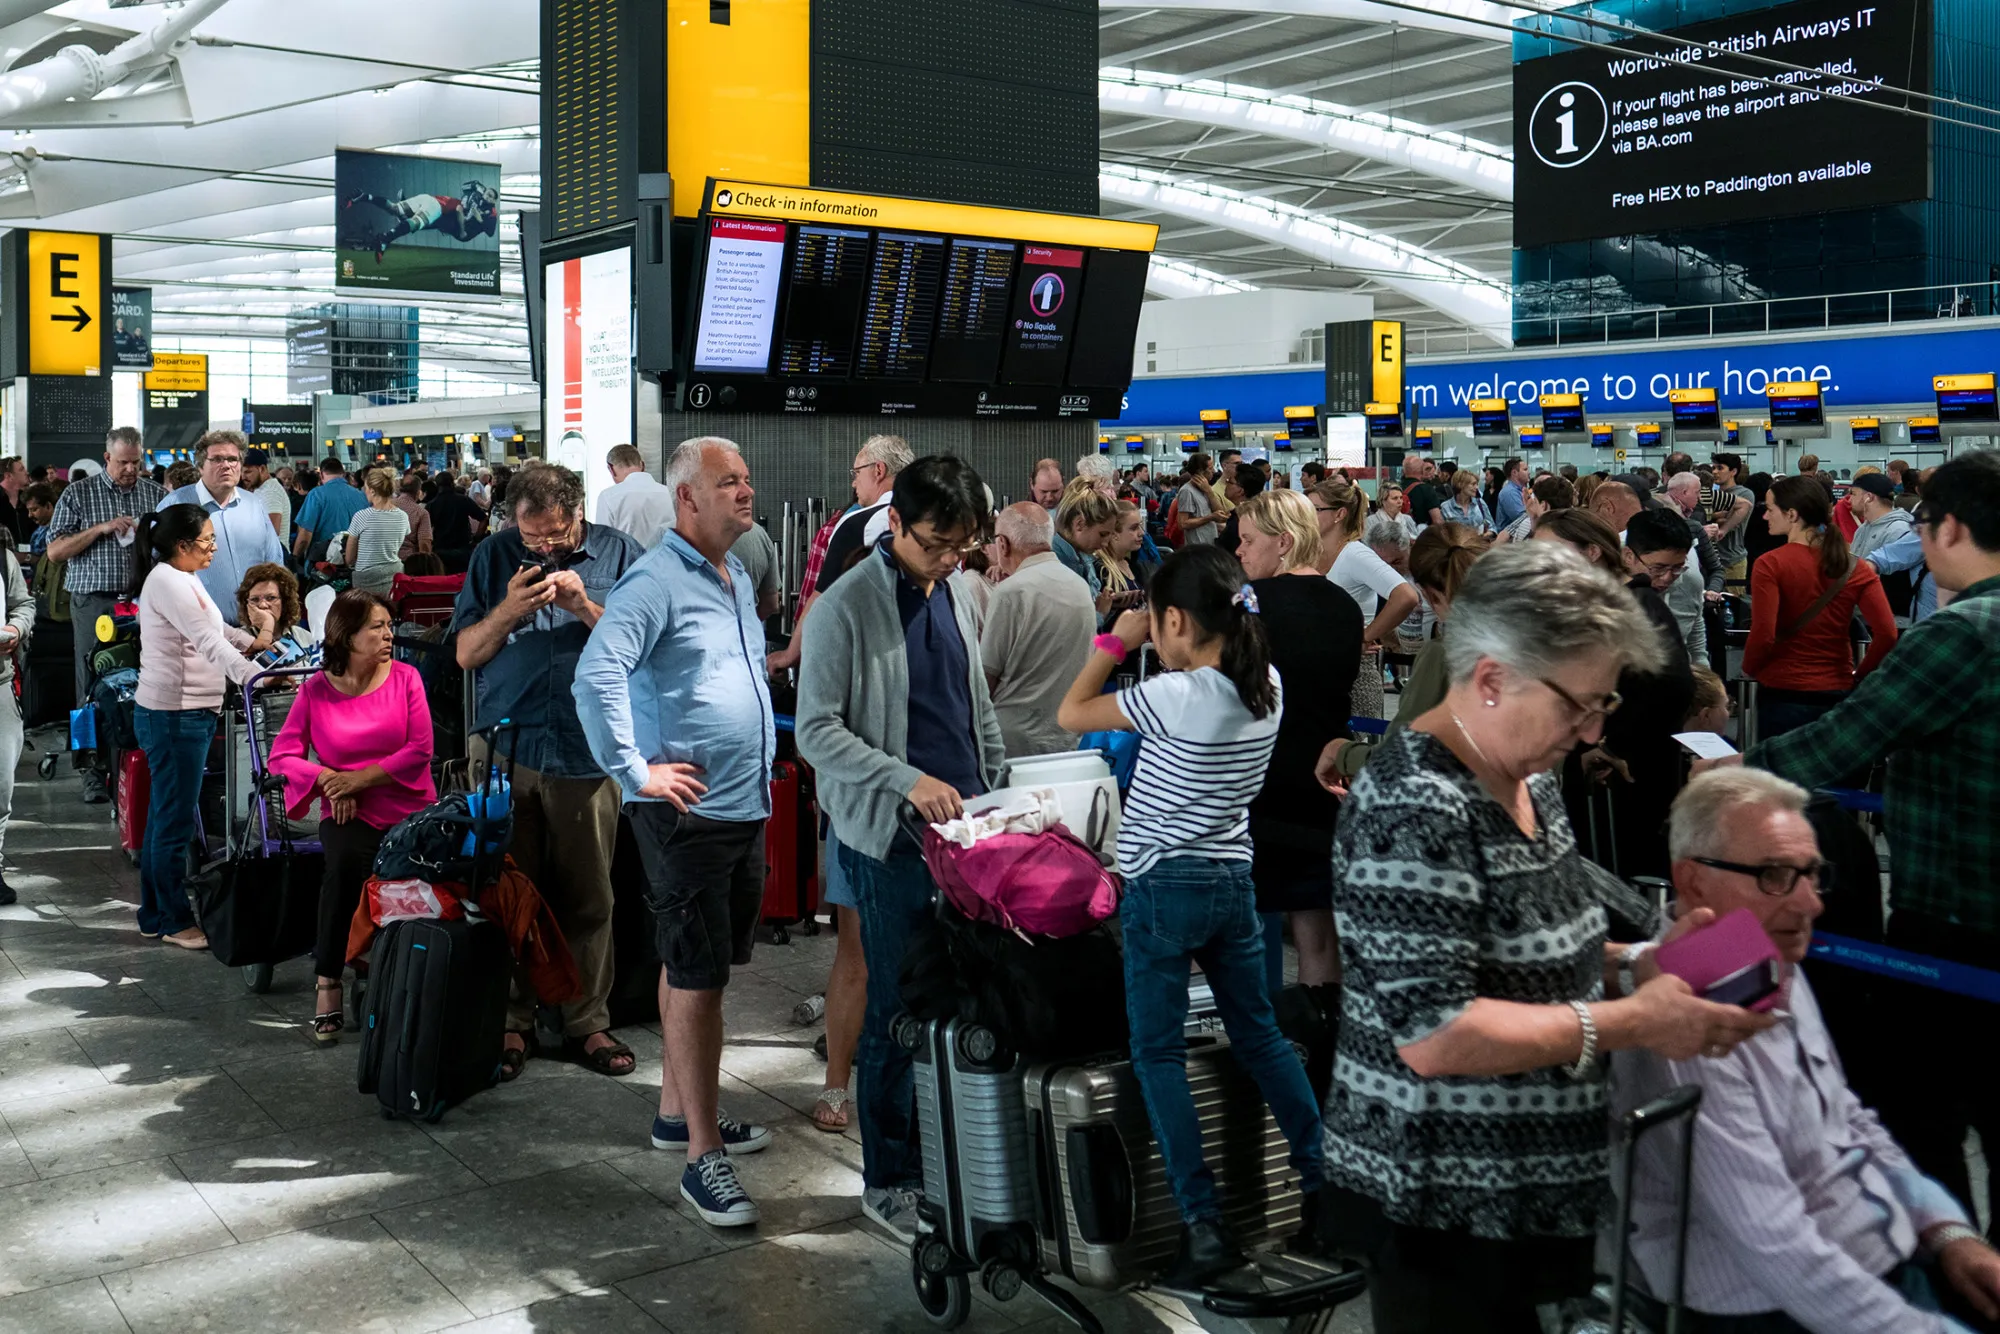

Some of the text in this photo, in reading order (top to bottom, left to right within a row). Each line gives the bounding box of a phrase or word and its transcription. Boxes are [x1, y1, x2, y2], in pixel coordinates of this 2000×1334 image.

[1607, 8, 1876, 78] Worldwide British Airways IT
[1612, 75, 1883, 138] please leave the airport and rebook
[1613, 100, 1622, 116] If
[1625, 97, 1656, 117] your
[1660, 88, 1695, 108] flight
[1699, 85, 1726, 100] has
[1731, 77, 1769, 94] been
[1612, 131, 1693, 154] via BA.com
[1612, 160, 1872, 208] Free HEX to Paddington available
[736, 192, 878, 218] Check-in information
[742, 223, 777, 232] information
[1032, 249, 1053, 258] Security
[50, 252, 80, 298] E
[450, 271, 495, 281] Standard Life
[454, 278, 495, 287] Investments
[1023, 321, 1057, 331] No liquids
[1029, 332, 1064, 342] containers
[1381, 334, 1393, 362] E
[155, 357, 201, 366] Departures
[1448, 373, 1590, 406] welcome
[1602, 373, 1637, 401] to
[1650, 371, 1710, 398] our
[1724, 360, 1840, 396] home.
[258, 426, 310, 435] change the future
